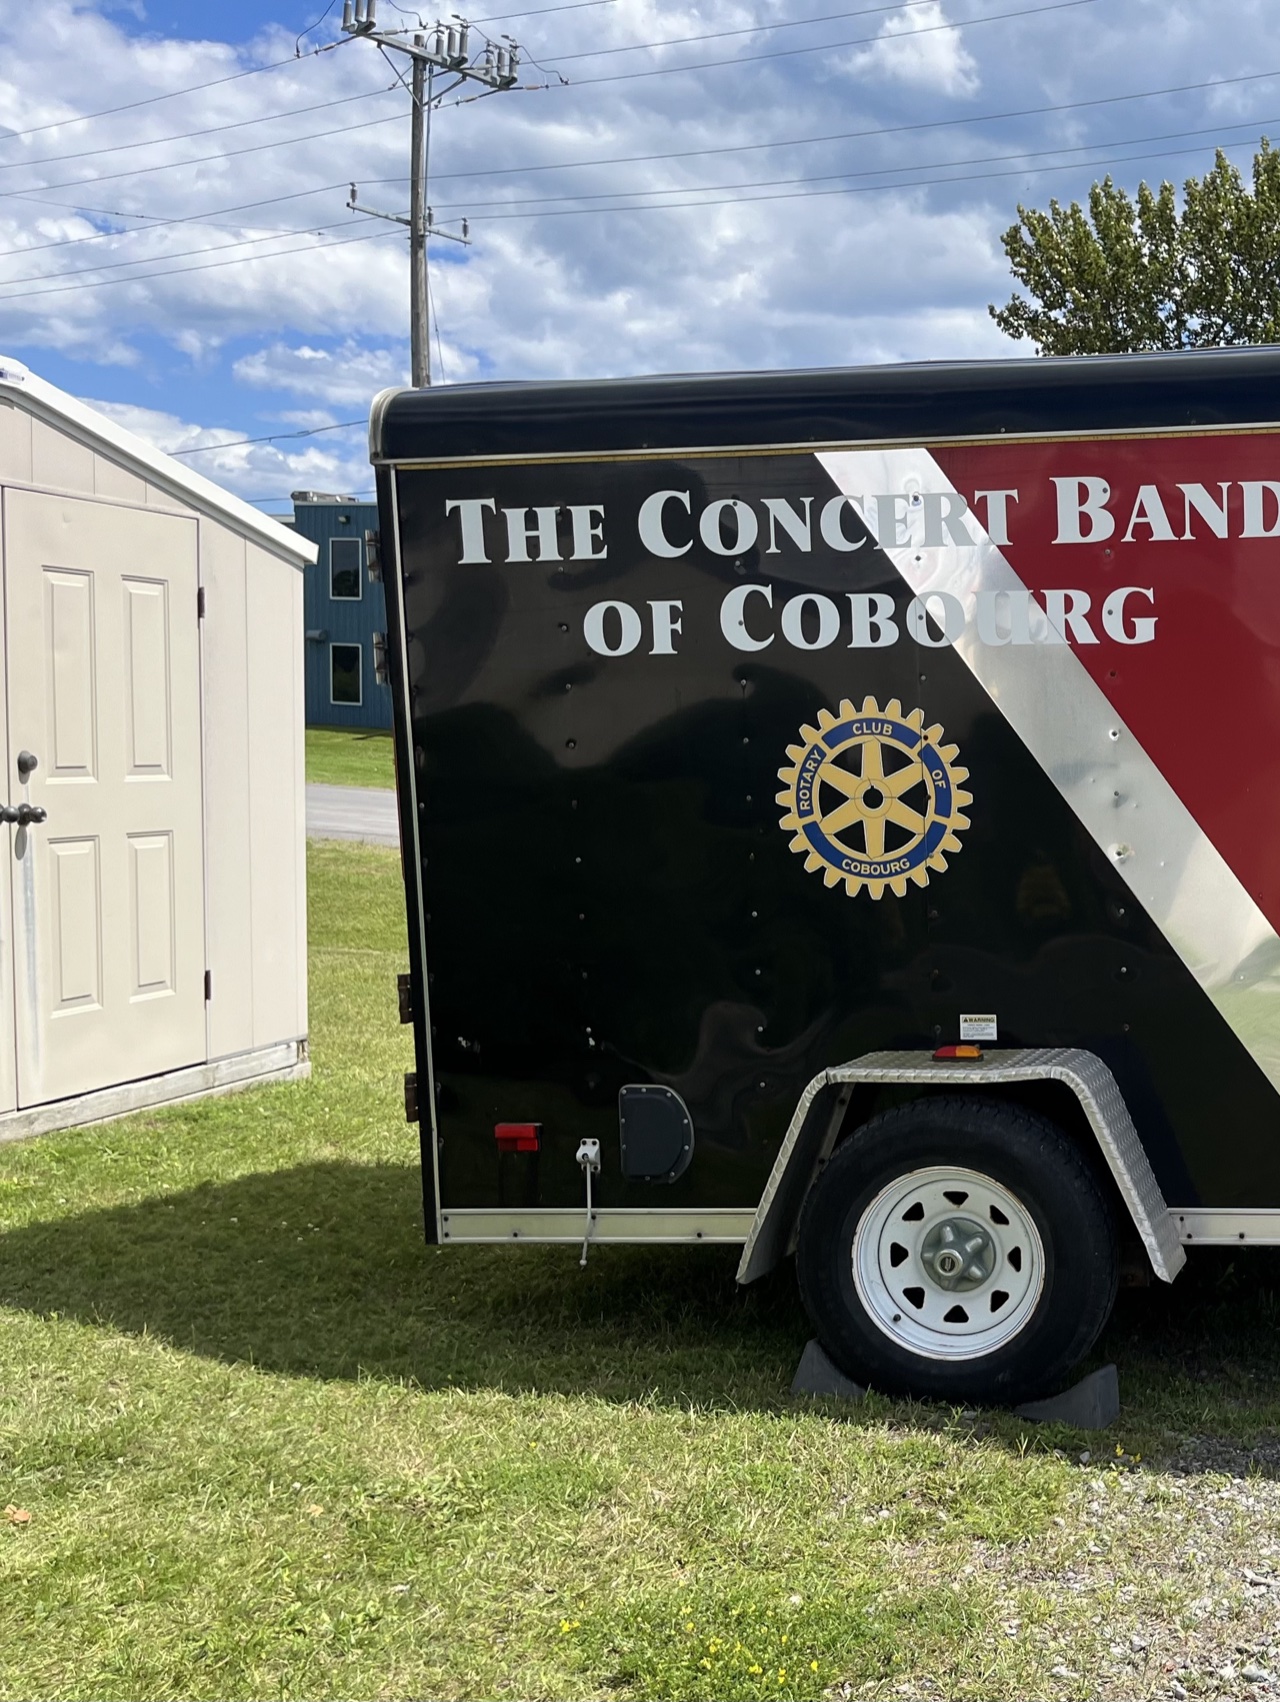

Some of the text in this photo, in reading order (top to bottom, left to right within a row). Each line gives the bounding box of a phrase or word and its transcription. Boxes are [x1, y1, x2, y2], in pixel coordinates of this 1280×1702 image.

[638, 489, 1019, 558] CONCERT
[719, 584, 1159, 652] COBOURG
[799, 722, 947, 811] ROTARY CLUB OF
[841, 858, 910, 876] COBOURG
